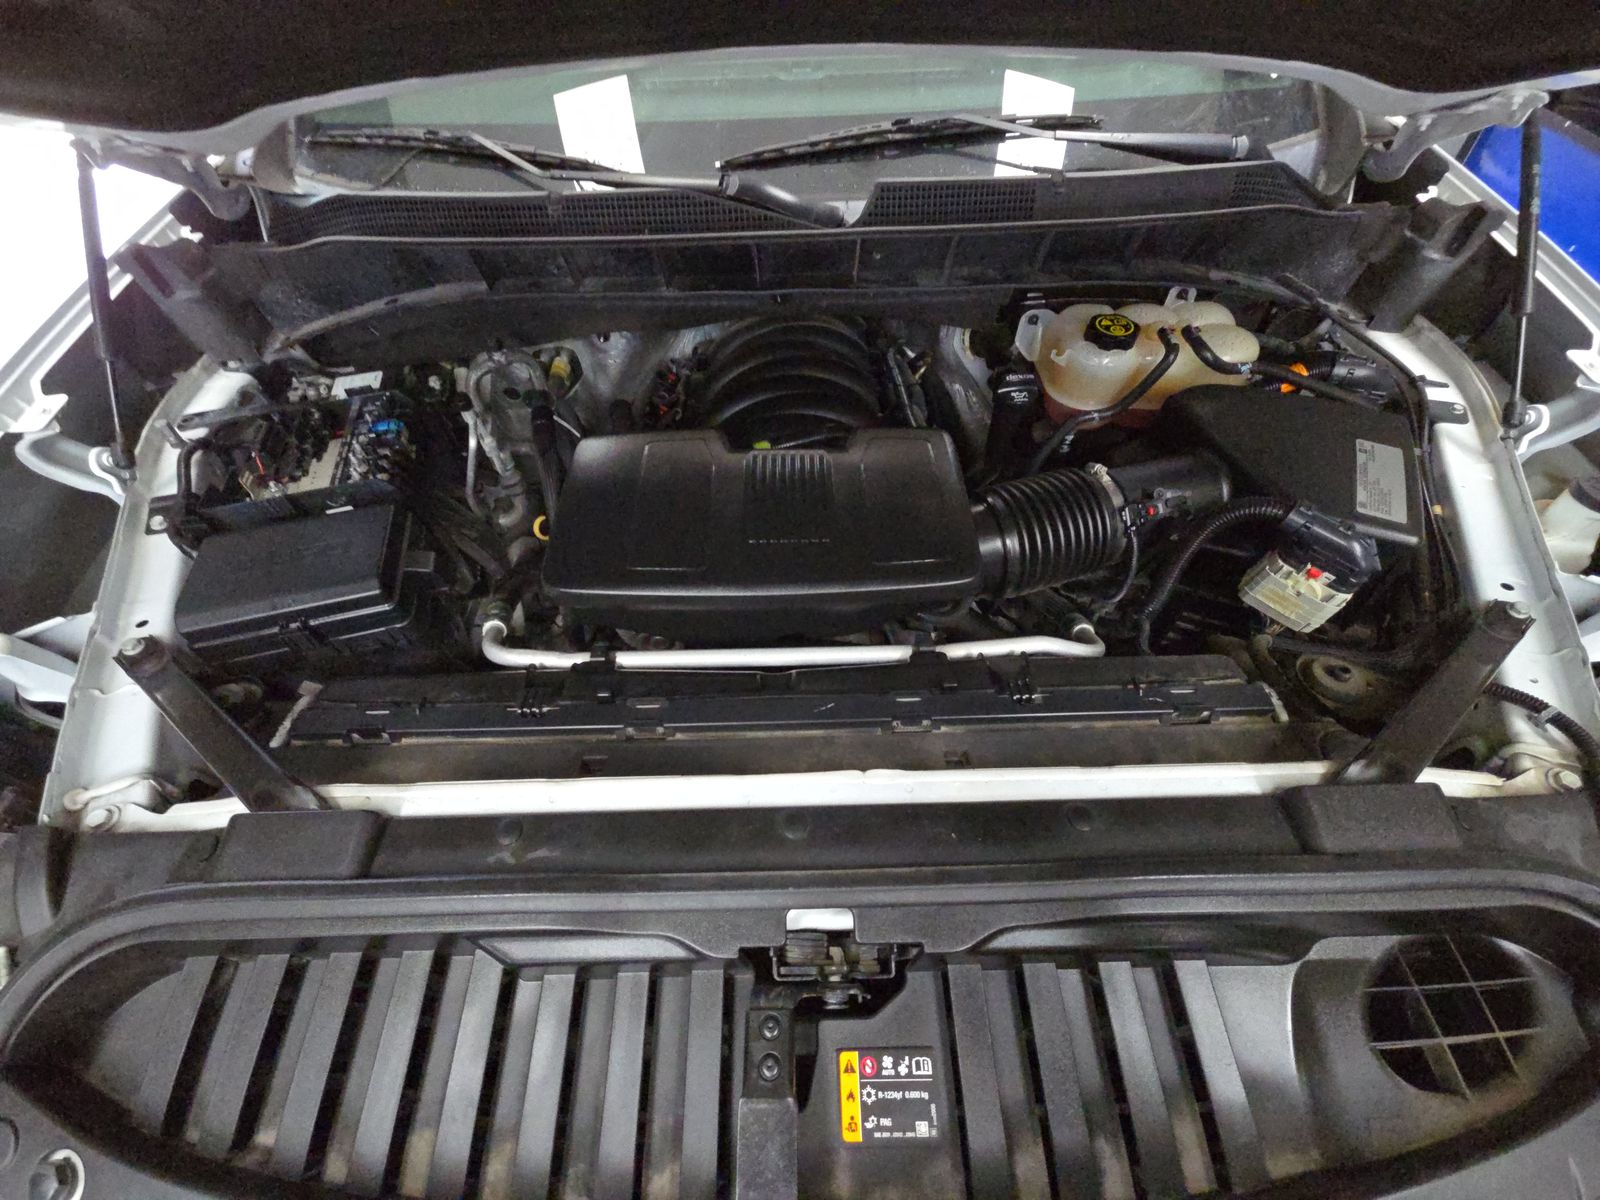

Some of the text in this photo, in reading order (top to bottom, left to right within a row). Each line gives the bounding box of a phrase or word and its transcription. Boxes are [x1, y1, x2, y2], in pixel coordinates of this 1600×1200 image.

[878, 1091, 903, 1100] R-1234yf
[921, 1091, 929, 1100] kg
[880, 1118, 892, 1126] PAG
